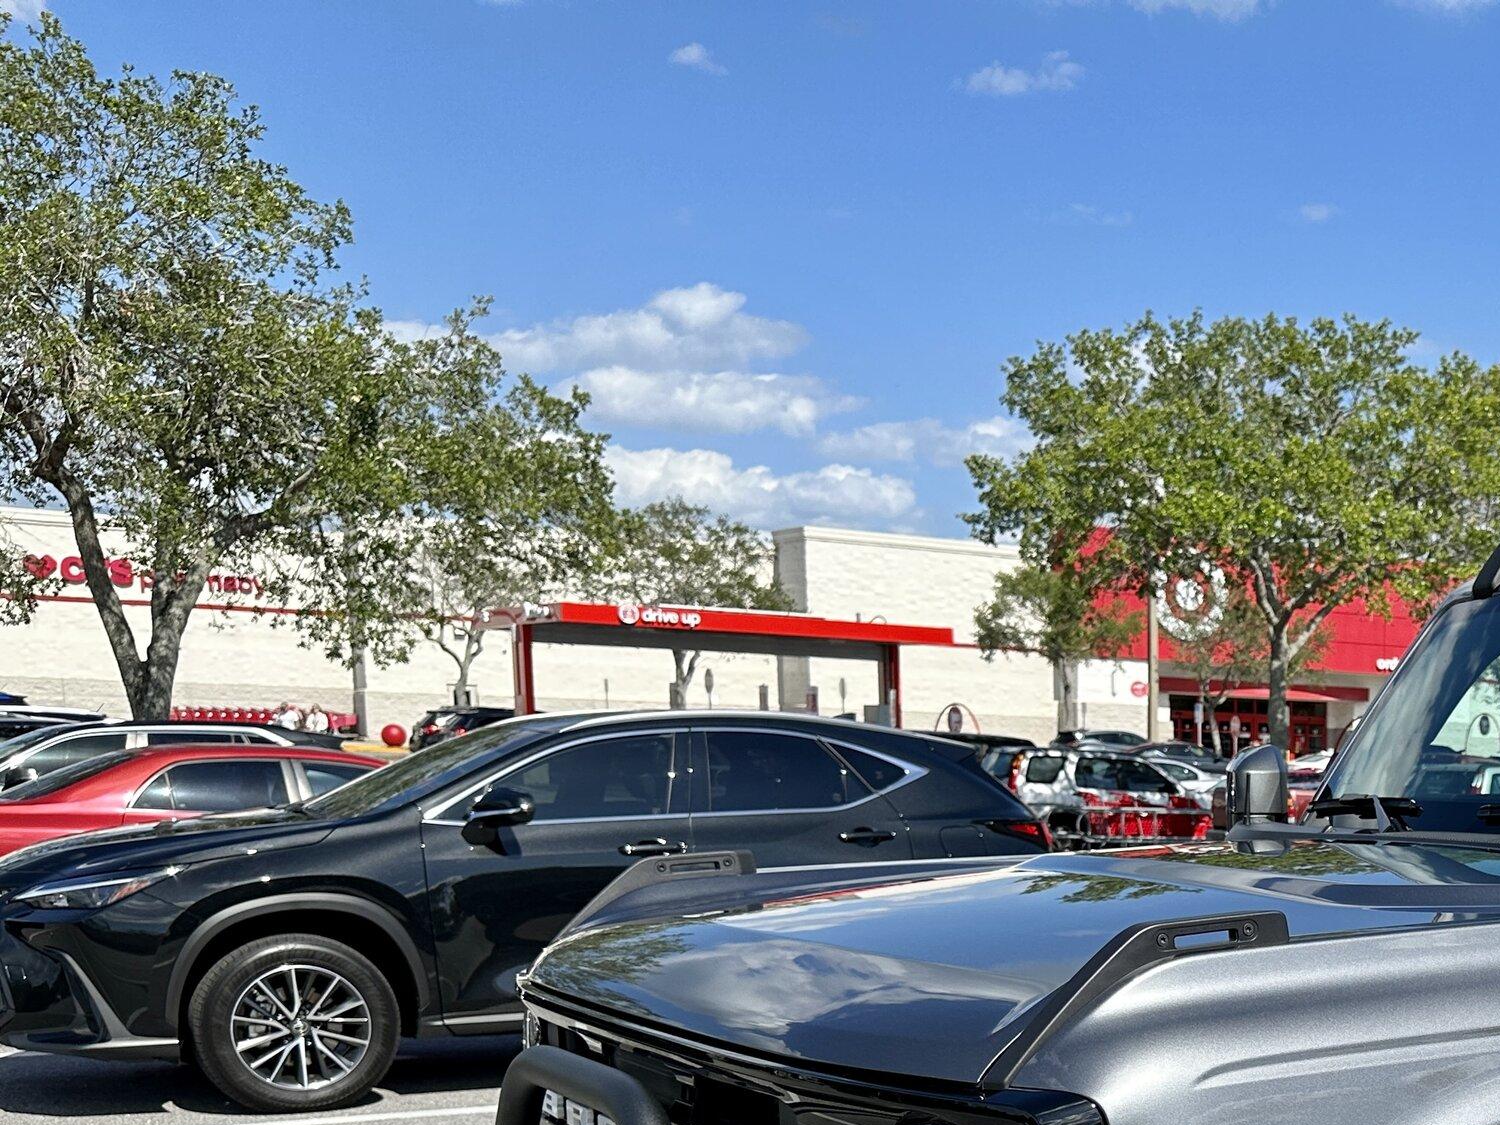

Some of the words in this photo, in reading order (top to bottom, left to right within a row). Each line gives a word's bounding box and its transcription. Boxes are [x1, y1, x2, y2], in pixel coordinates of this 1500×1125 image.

[60, 555, 134, 588] CS
[641, 606, 679, 624] drive
[681, 612, 701, 628] up
